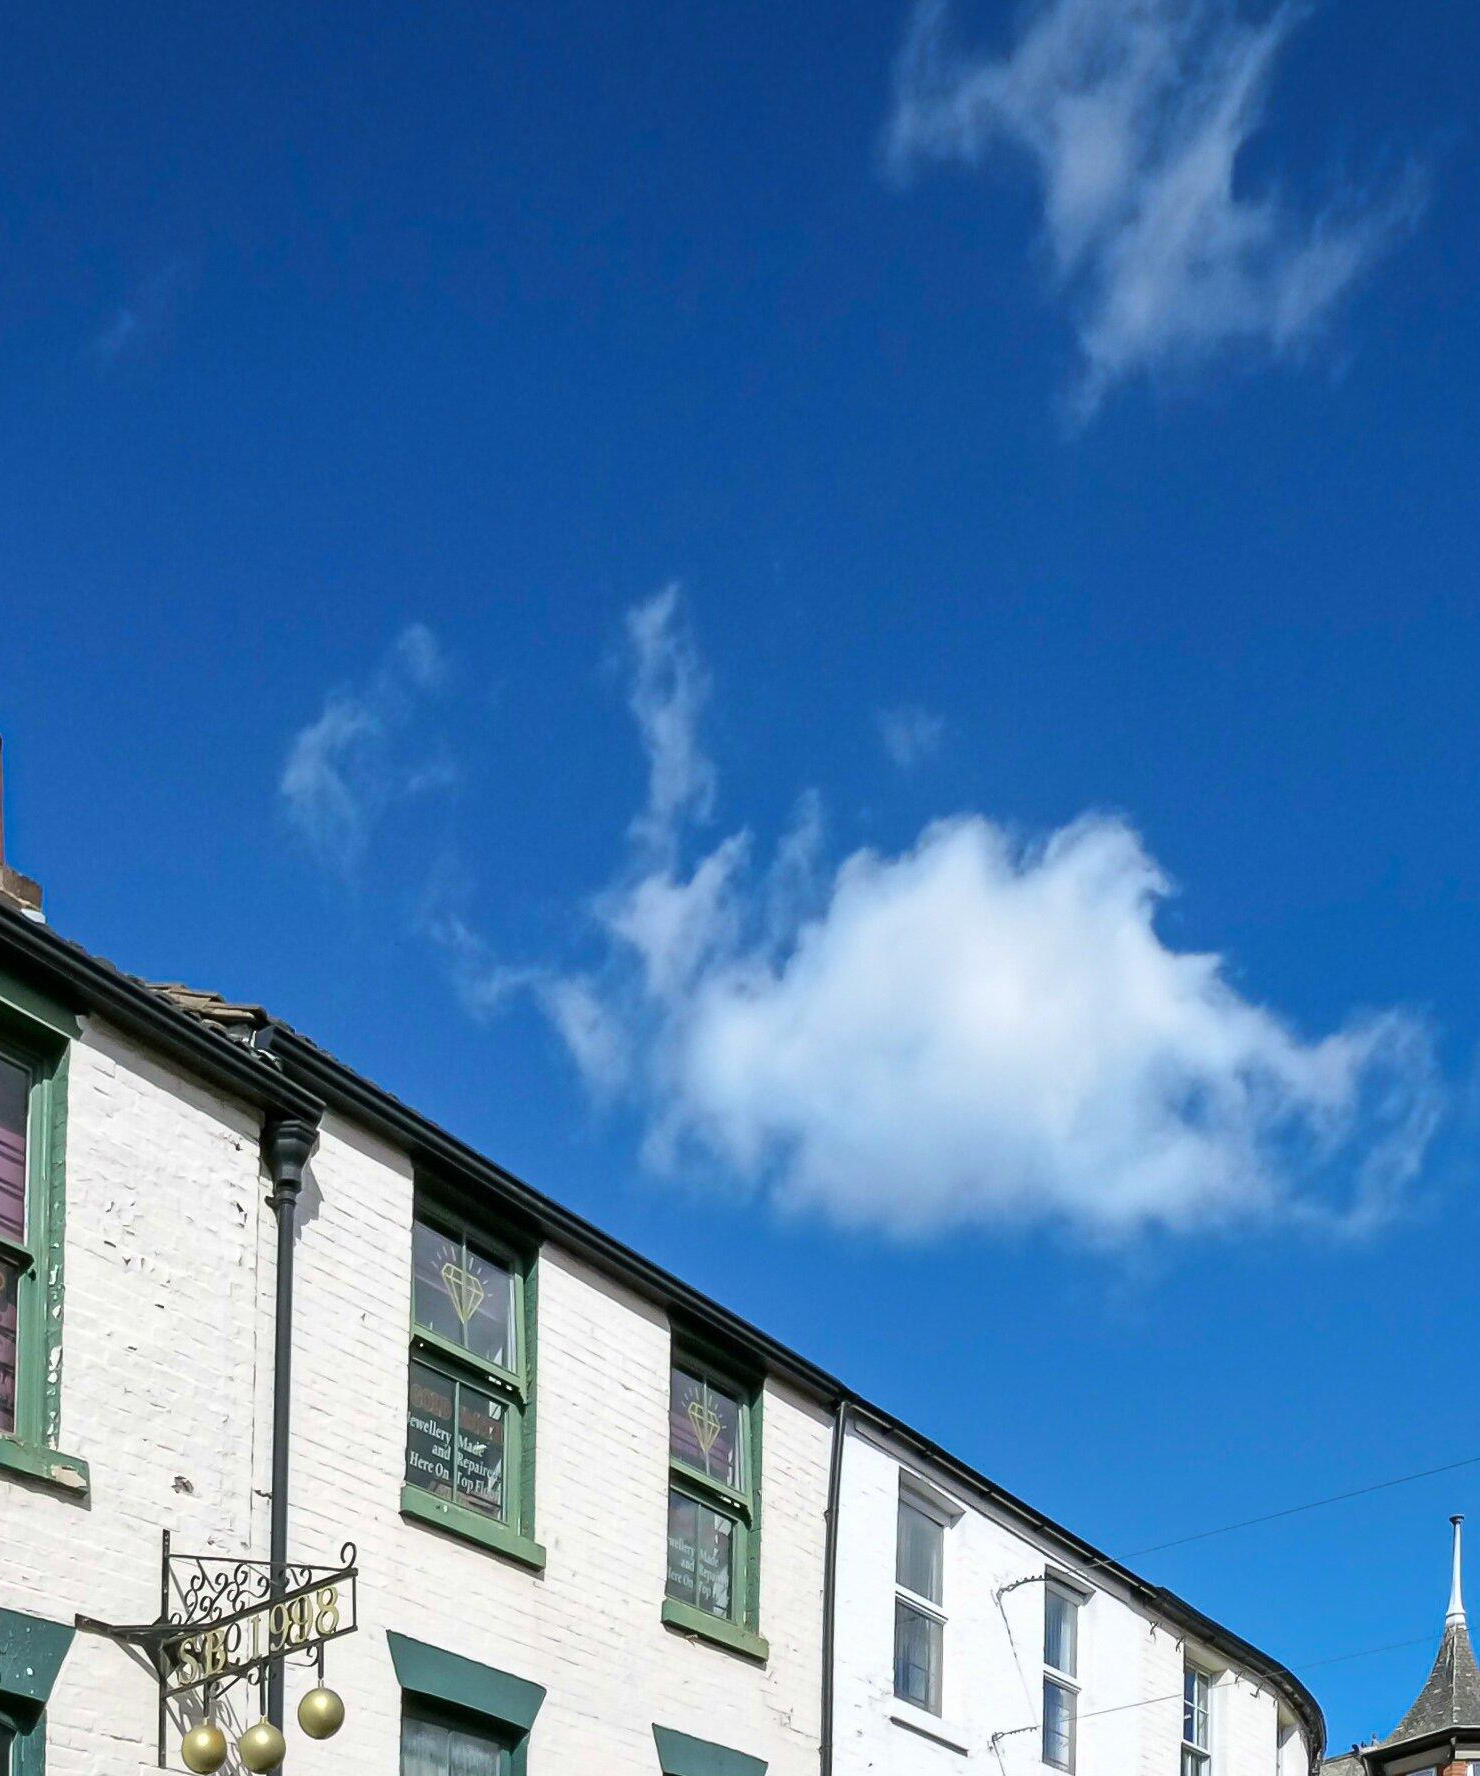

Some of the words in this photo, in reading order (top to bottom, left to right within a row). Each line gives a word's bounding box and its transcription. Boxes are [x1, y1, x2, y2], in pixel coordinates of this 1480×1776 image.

[431, 1443, 451, 1461] and
[409, 1451, 434, 1473] Here
[435, 1463, 450, 1481] On
